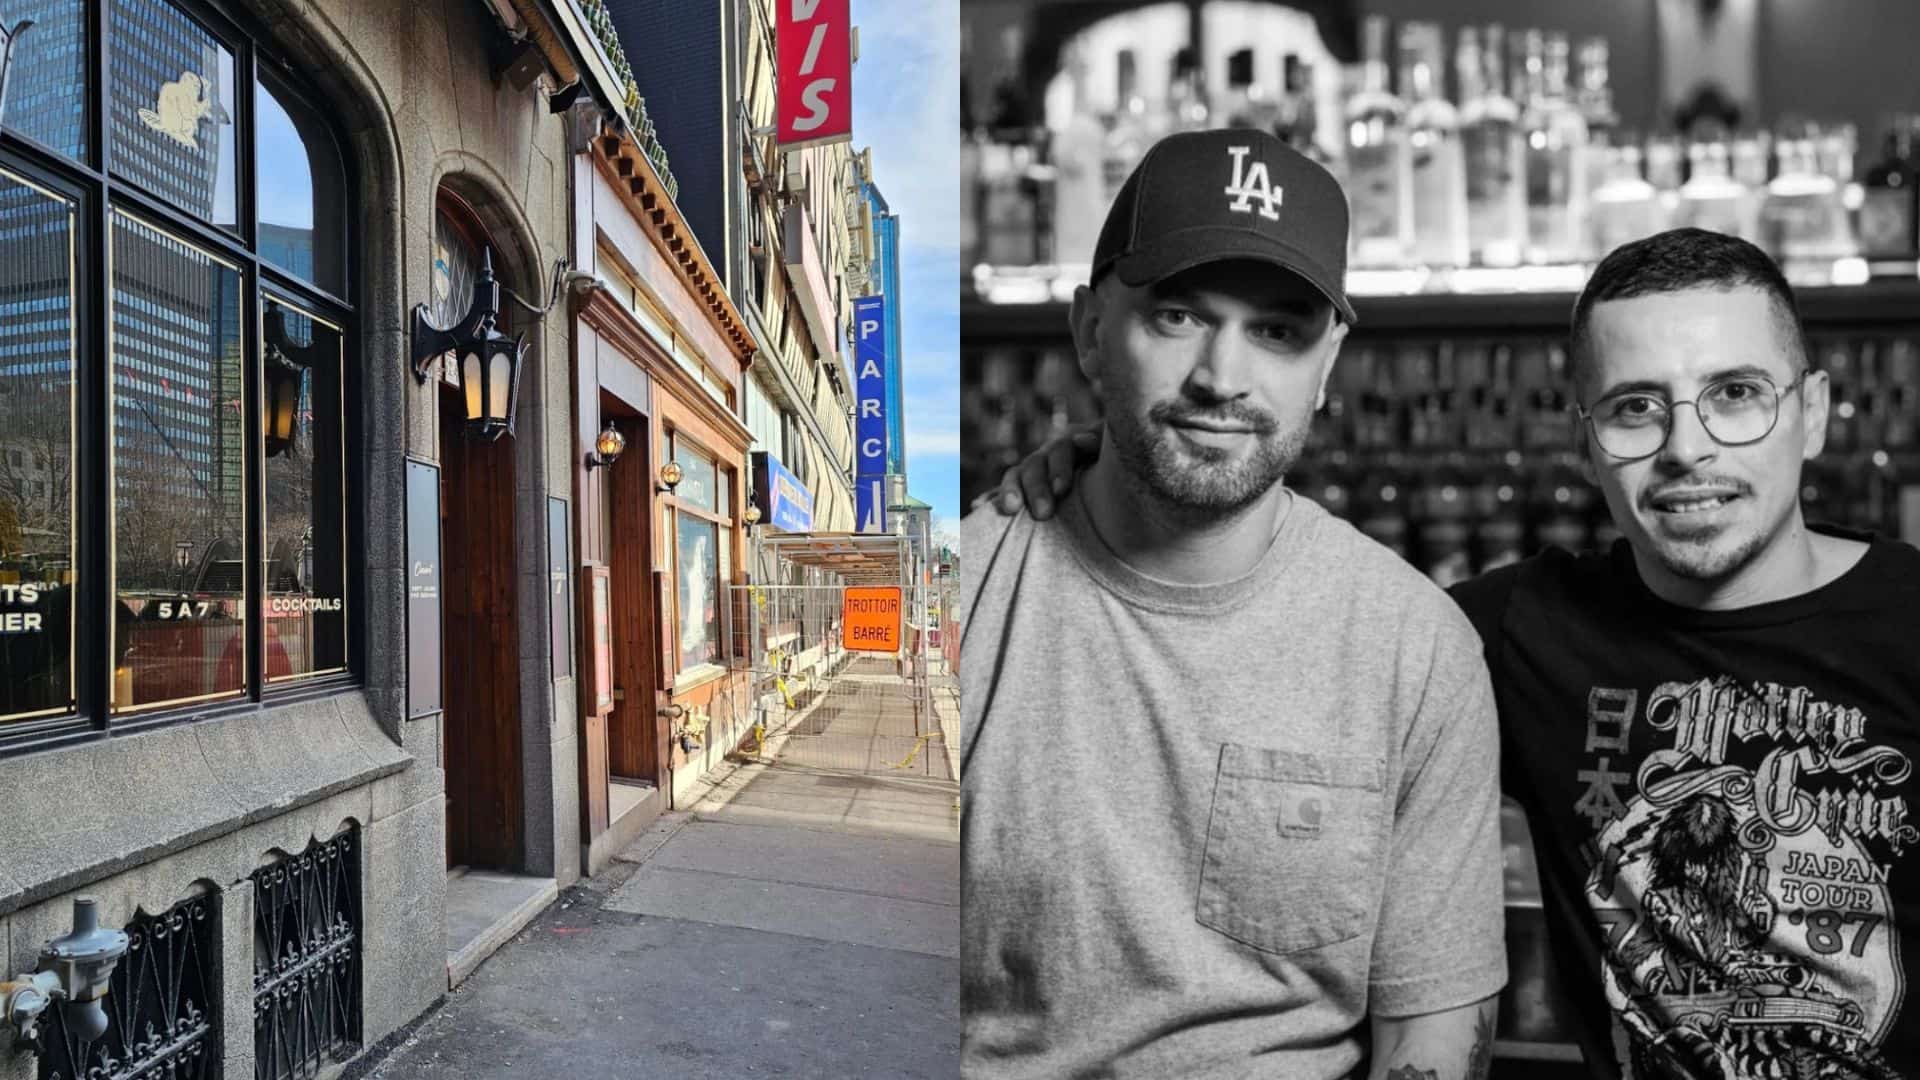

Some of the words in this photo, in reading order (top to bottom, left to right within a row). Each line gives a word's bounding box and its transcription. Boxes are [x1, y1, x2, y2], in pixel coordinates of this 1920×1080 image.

[1224, 146, 1283, 221] LA
[860, 319, 882, 458] PARC
[159, 603, 172, 618] 5
[197, 602, 209, 616] 7
[272, 598, 341, 611] COCKTAILS
[848, 599, 897, 612] TROTTOIR
[0, 612, 42, 631] ER
[853, 624, 891, 641] BARRÉ
[1783, 851, 1892, 884] JAPAN
[1781, 879, 1872, 910] TOUR
[1788, 908, 1884, 957] '87
